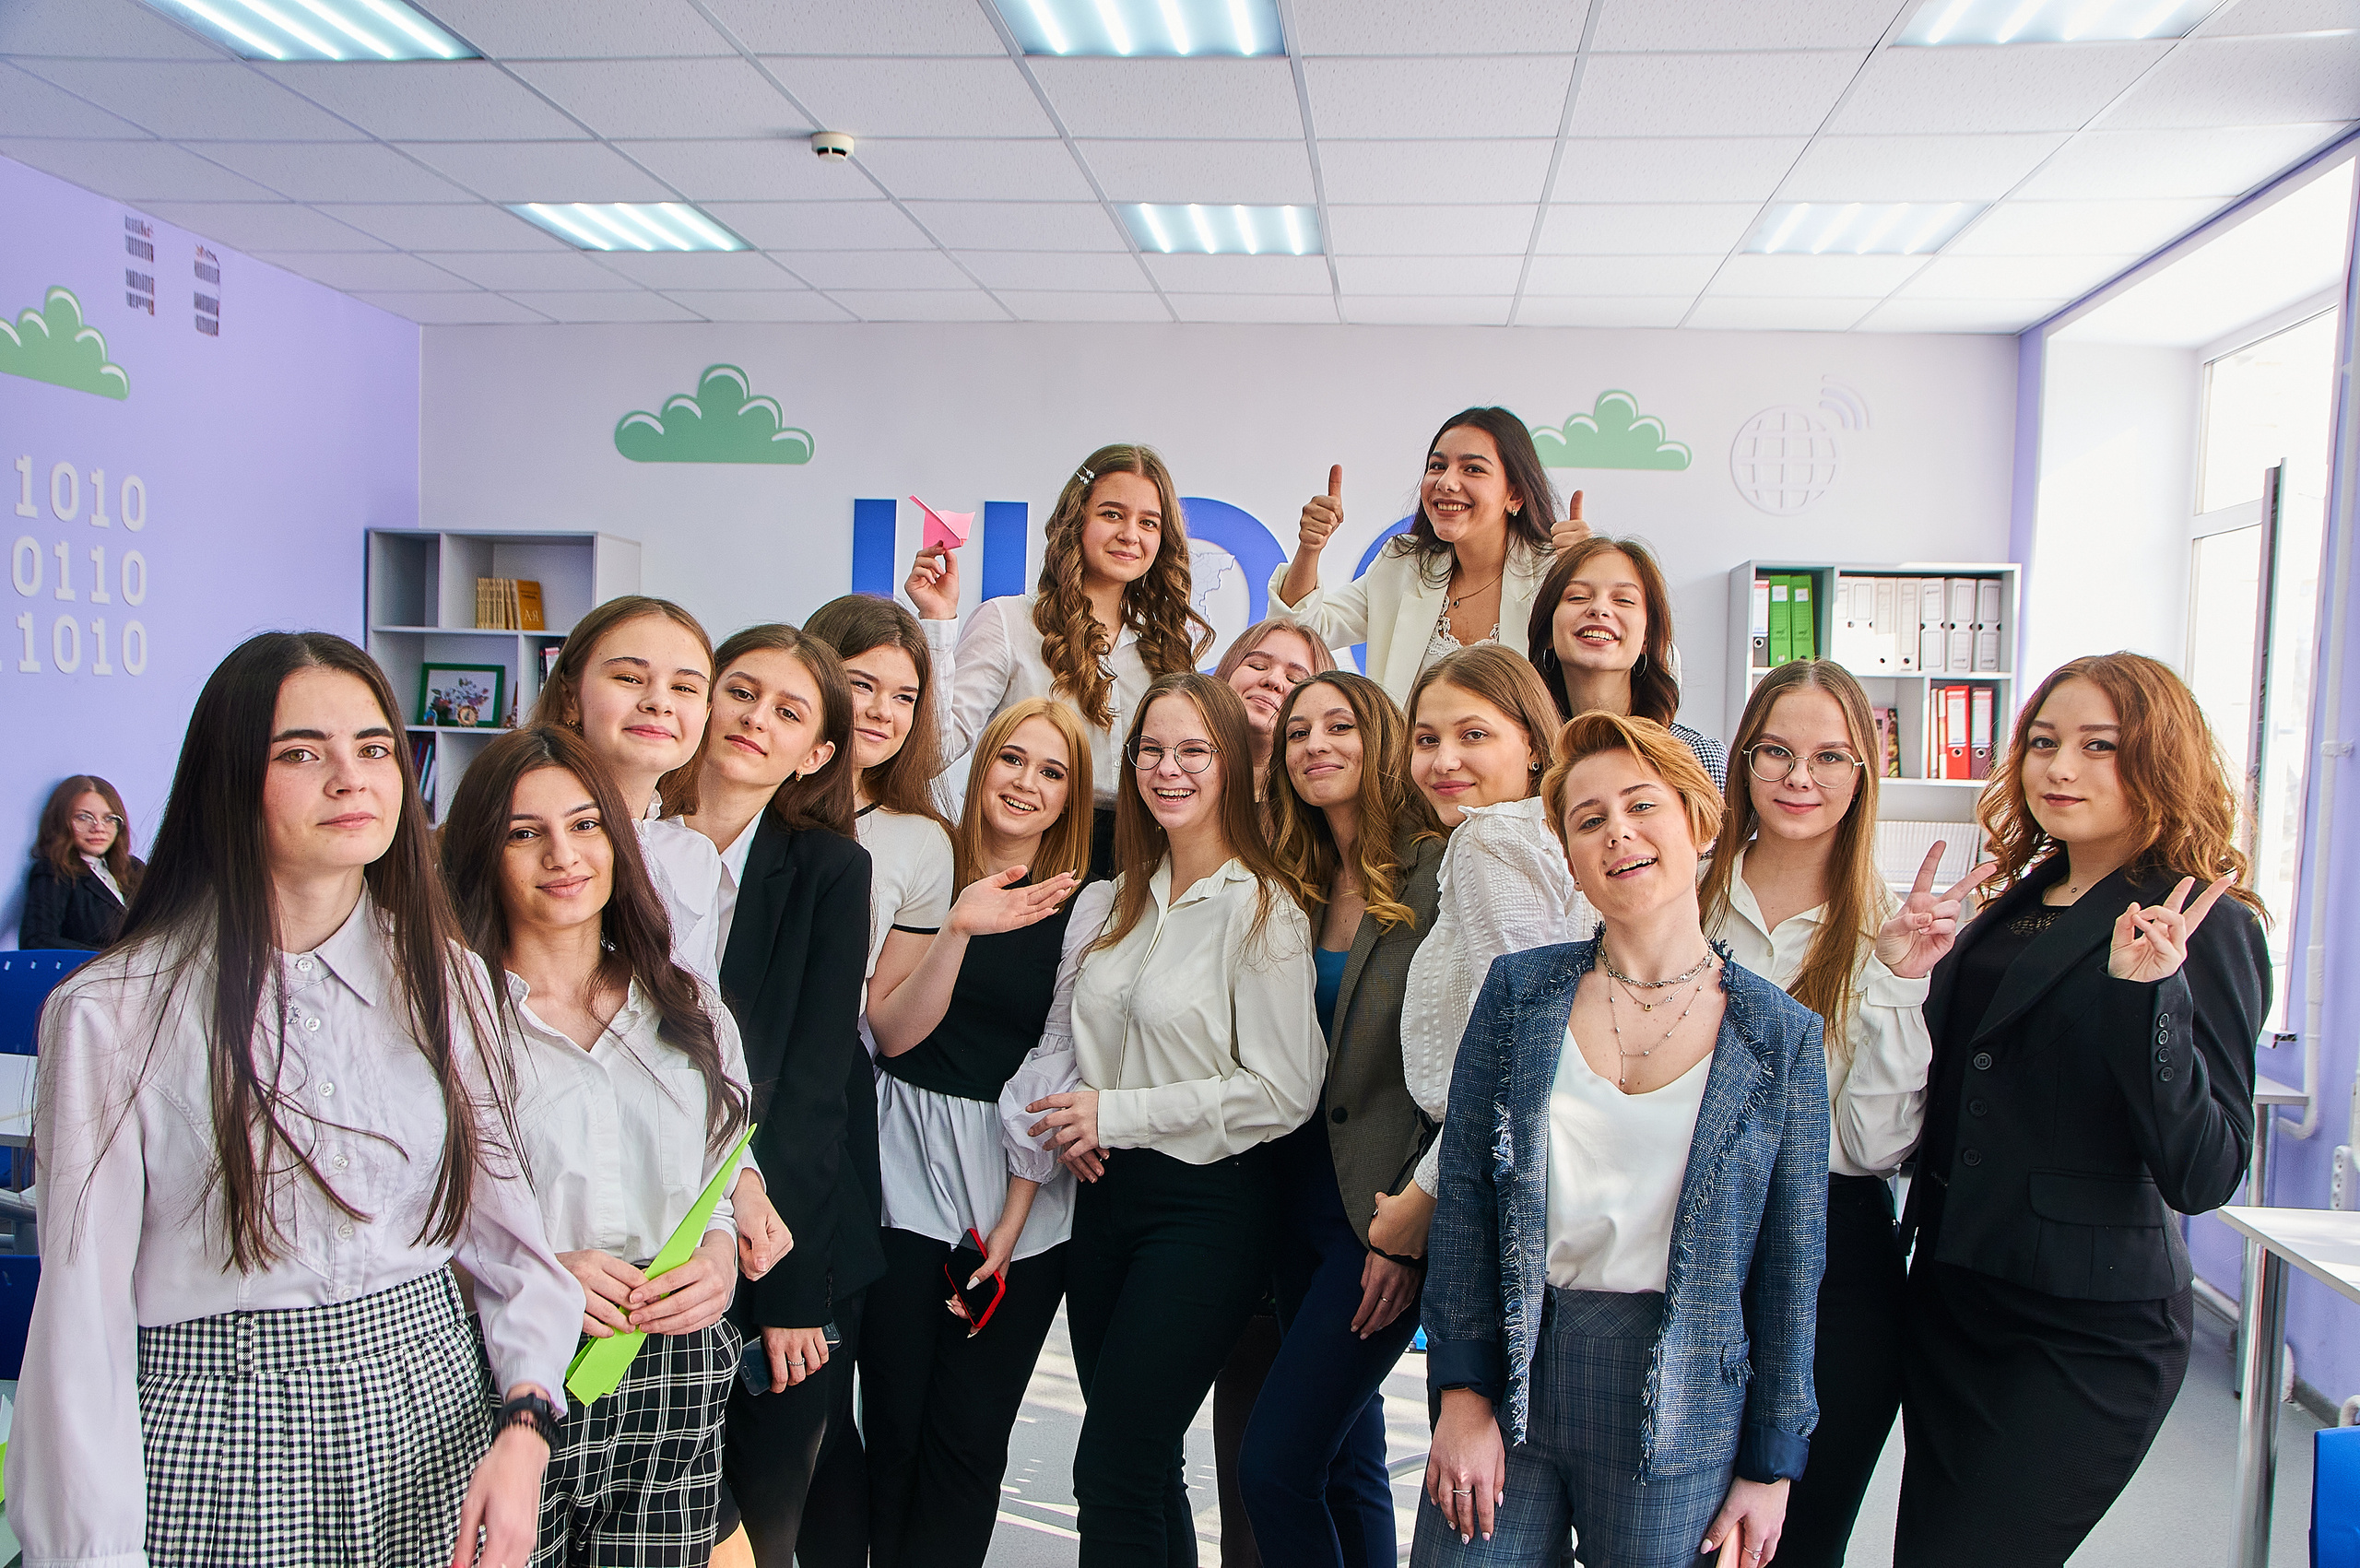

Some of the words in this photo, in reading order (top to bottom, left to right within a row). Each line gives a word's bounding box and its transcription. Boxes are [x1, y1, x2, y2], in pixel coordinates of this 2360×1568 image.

[15, 454, 146, 532] 1010
[11, 536, 146, 607] 0110
[0, 612, 147, 677] 1010
